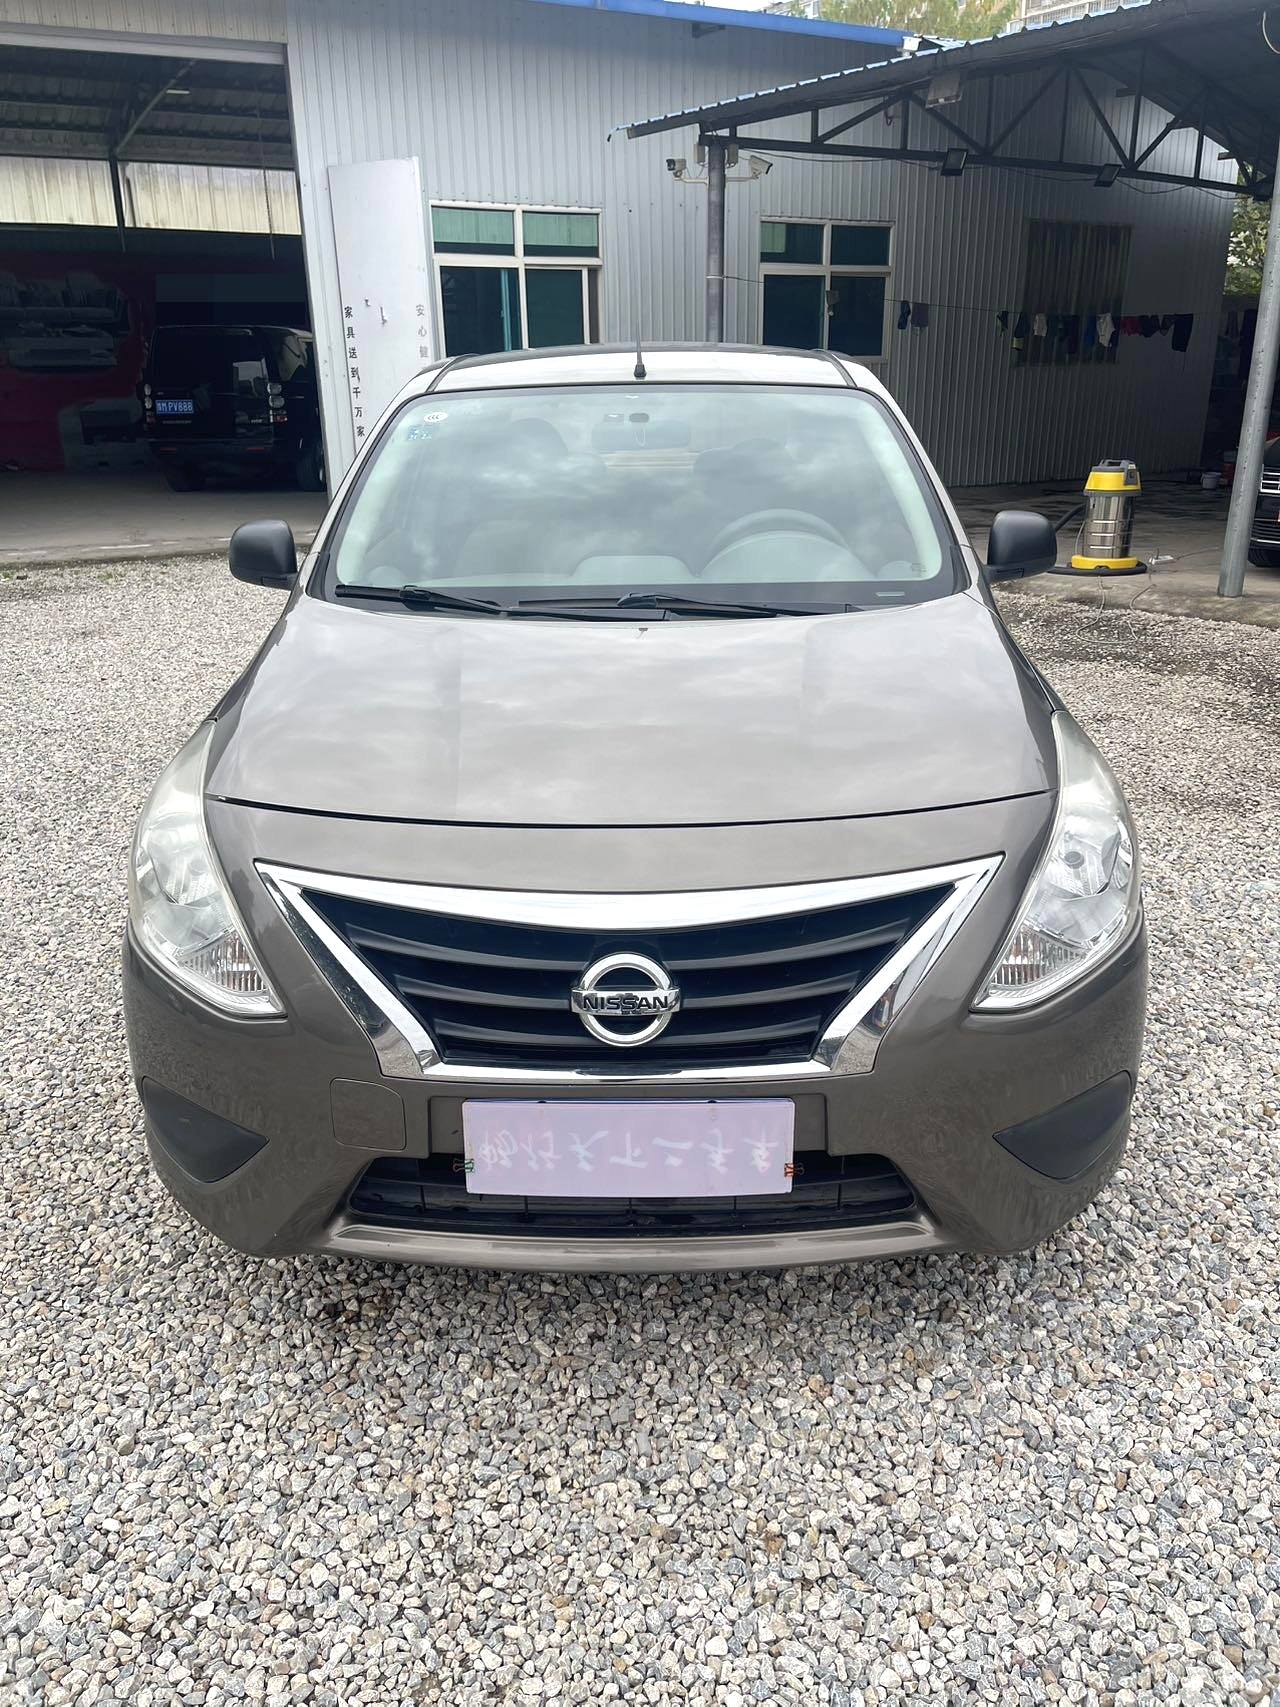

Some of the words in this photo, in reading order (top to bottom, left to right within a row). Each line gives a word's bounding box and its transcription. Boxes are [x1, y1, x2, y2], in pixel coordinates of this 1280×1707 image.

[344, 306, 366, 437] 家具送到千万家
[583, 996, 669, 1010] NISSAN
